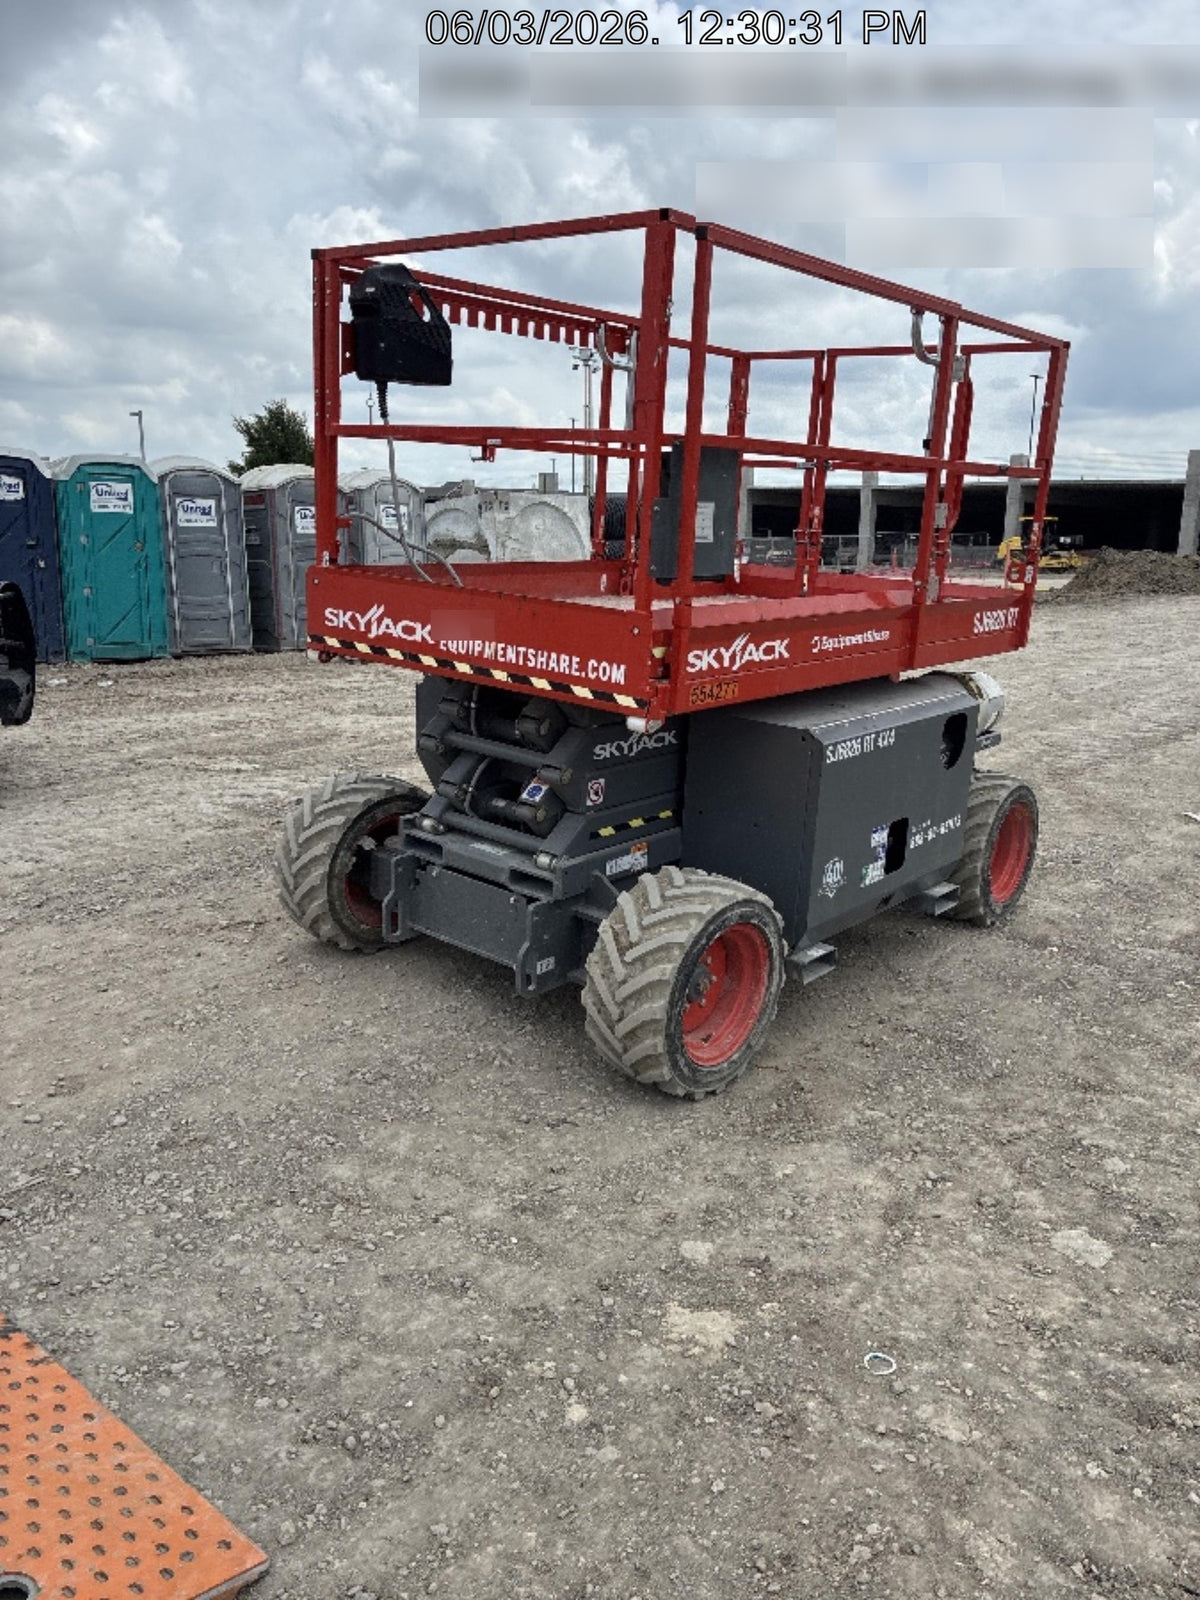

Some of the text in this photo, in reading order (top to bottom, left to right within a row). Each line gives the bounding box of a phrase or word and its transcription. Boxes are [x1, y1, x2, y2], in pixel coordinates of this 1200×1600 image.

[324, 603, 435, 644] SKYJACK
[686, 632, 790, 673] SKYJACK
[691, 680, 739, 705] 554277
[593, 729, 678, 760] SKYJACK
[863, 733, 876, 753] RT
